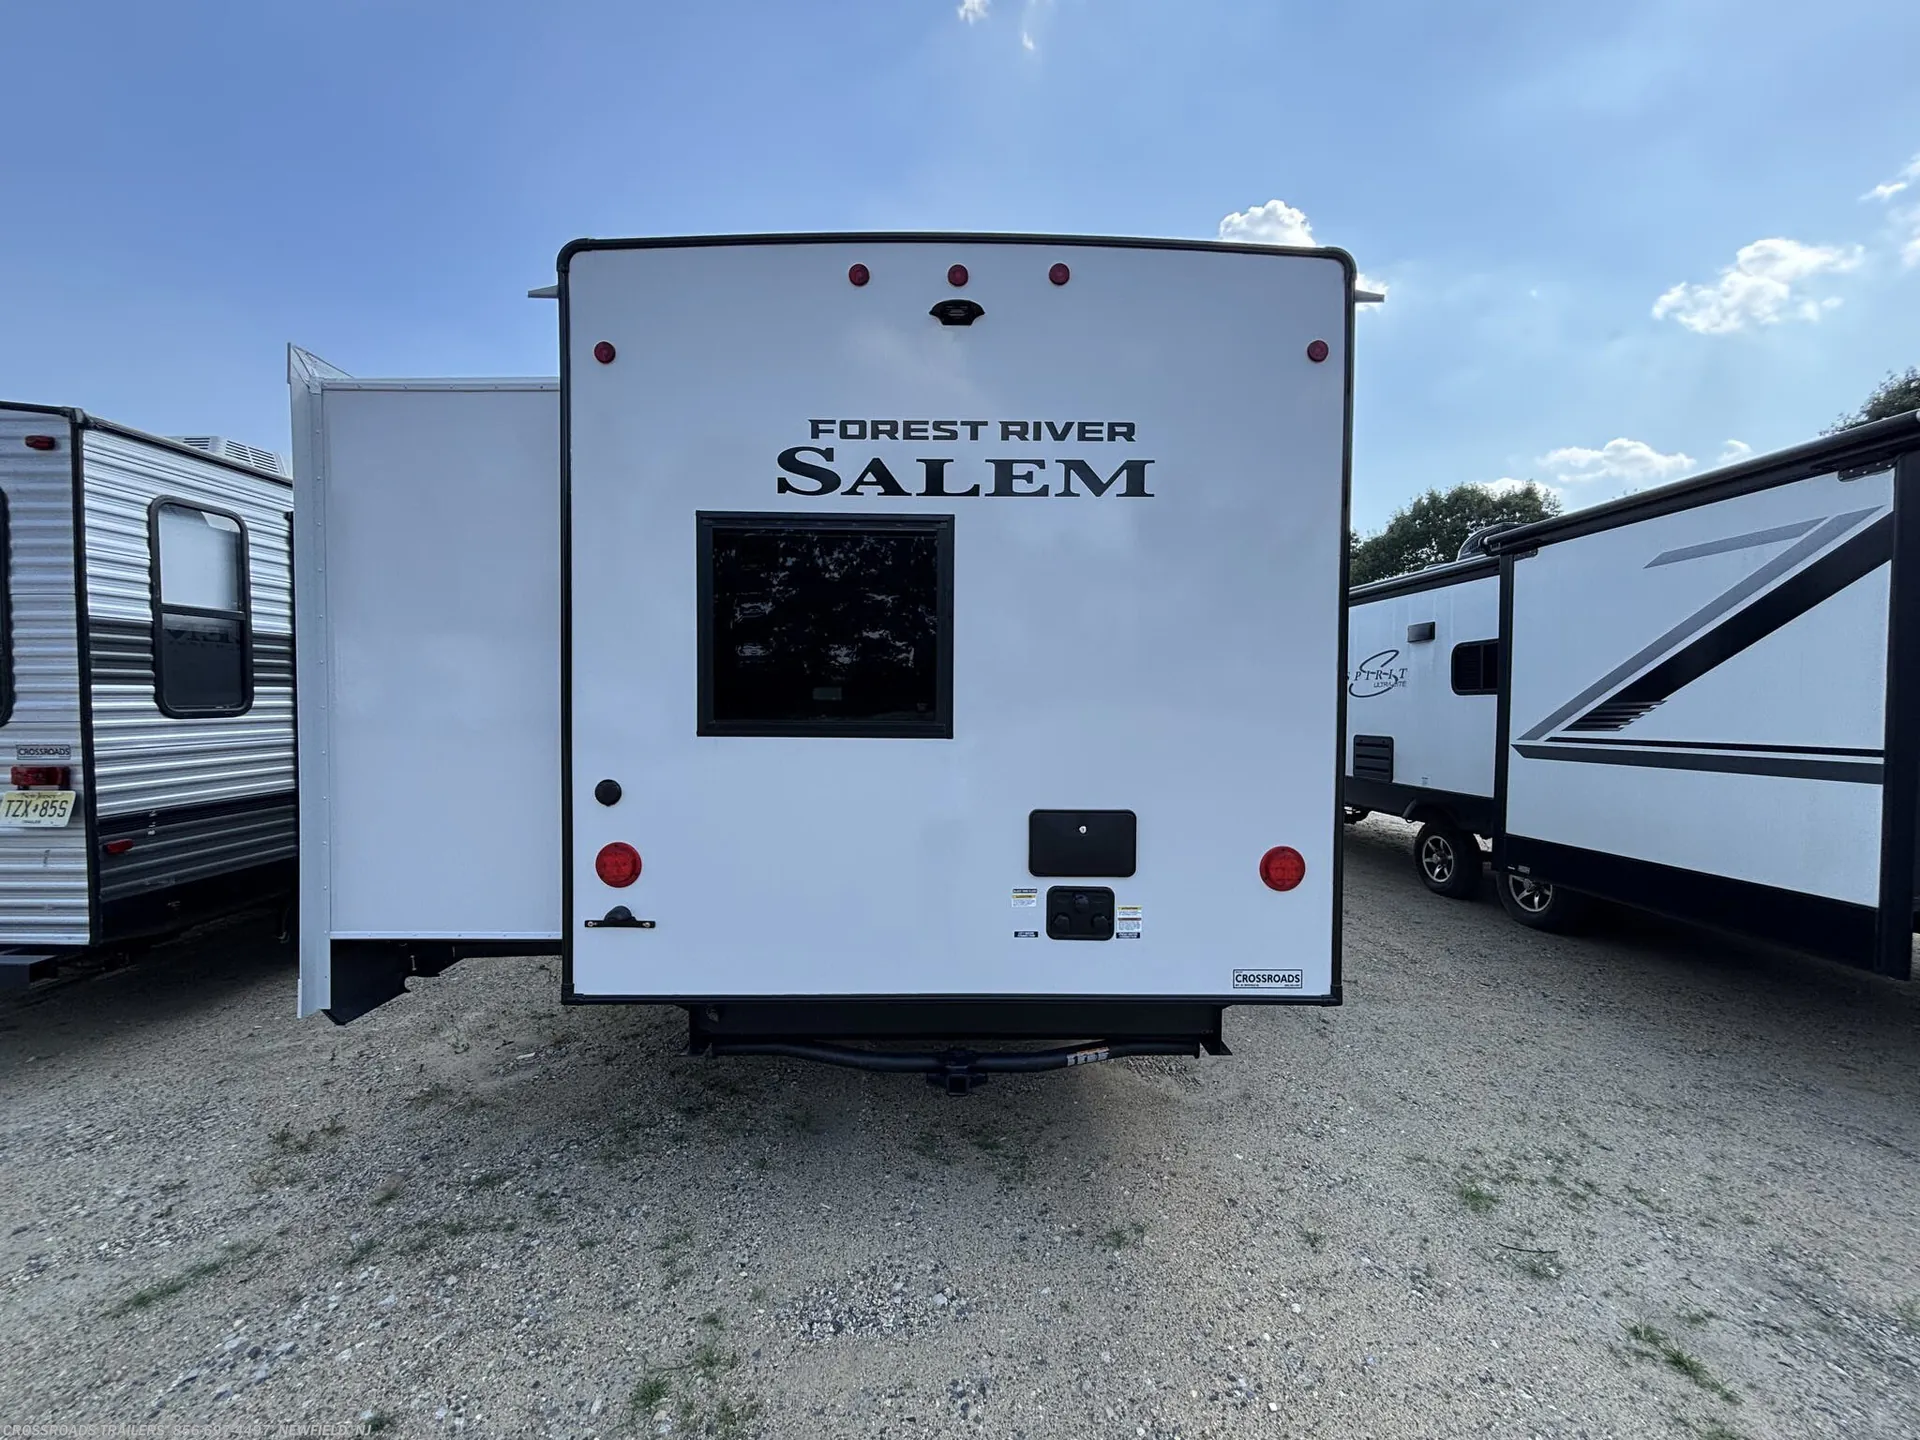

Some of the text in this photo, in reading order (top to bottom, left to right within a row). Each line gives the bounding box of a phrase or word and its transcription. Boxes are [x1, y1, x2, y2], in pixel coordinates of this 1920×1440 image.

[808, 419, 1136, 442] FOREST RIVER
[777, 446, 1155, 497] SALEM
[18, 748, 70, 756] CROSSROADS
[5, 800, 32, 817] TZX
[1235, 974, 1300, 983] CROSSROADS
